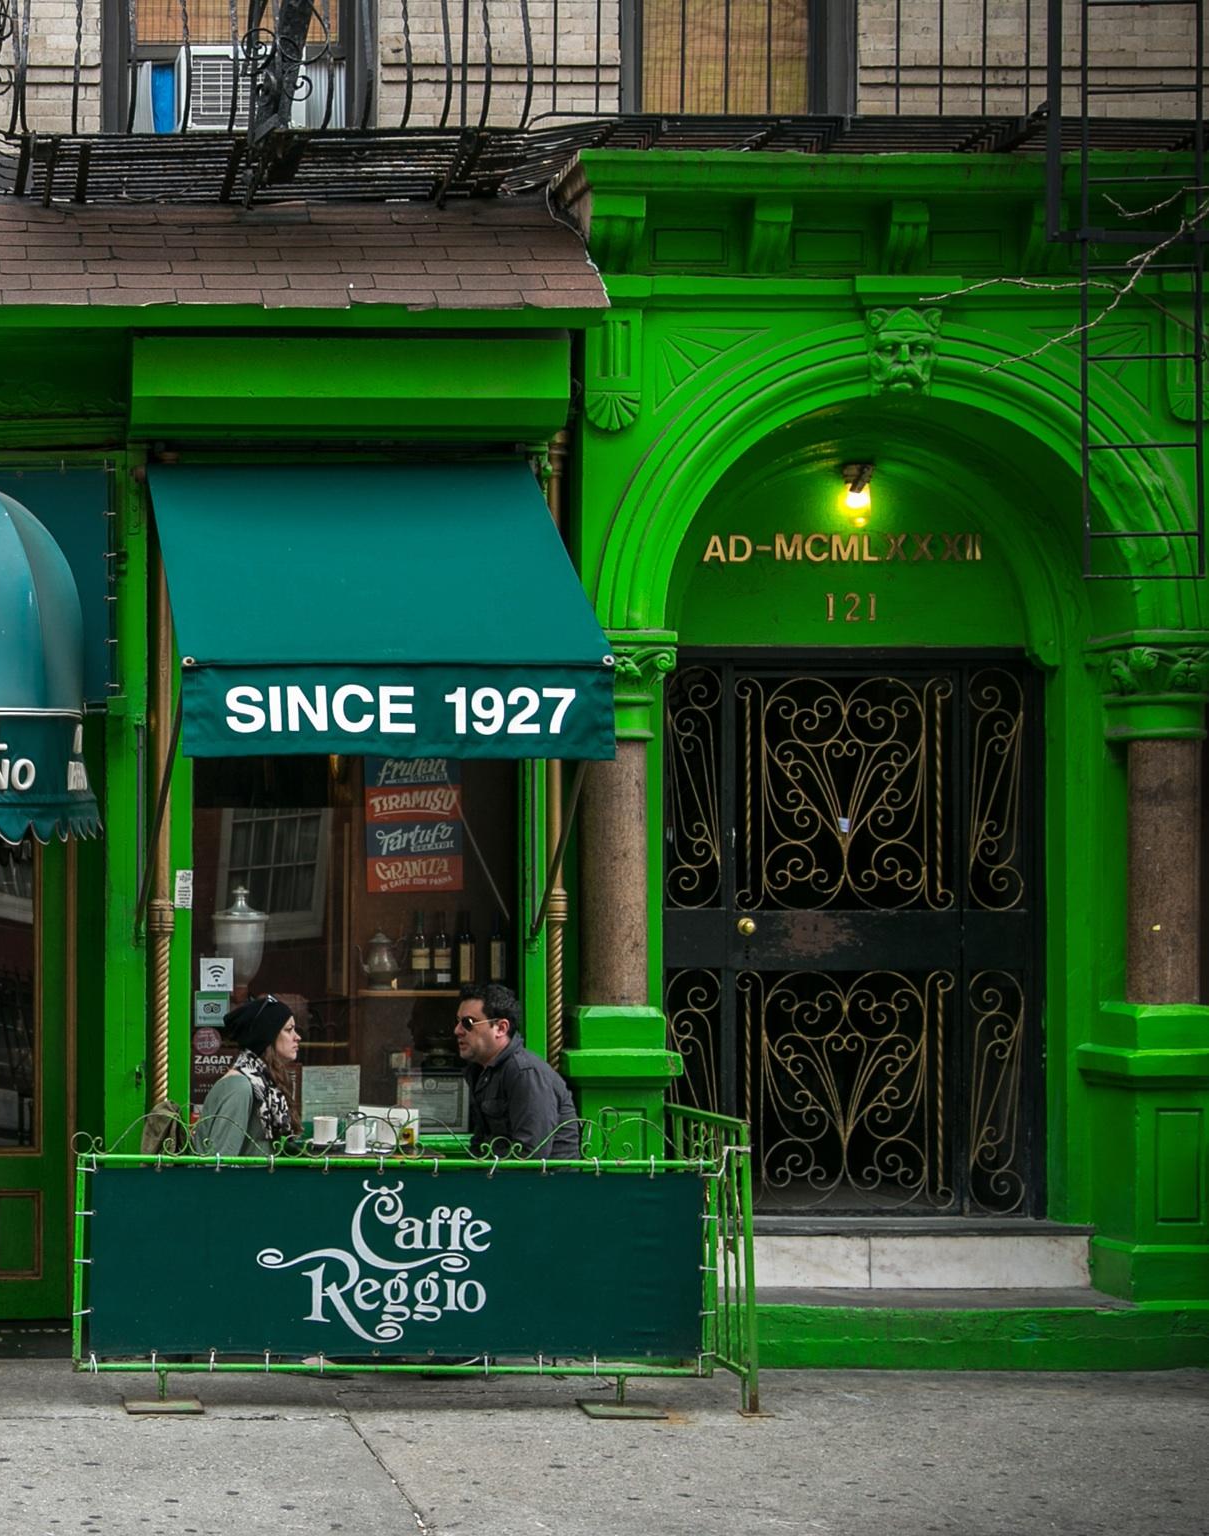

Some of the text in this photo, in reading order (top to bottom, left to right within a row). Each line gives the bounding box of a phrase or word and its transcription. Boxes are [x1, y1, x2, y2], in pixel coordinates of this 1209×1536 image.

[825, 592, 877, 622] 121
[225, 685, 577, 736] SINCE 1927
[375, 822, 454, 856] Tartufo
[375, 858, 450, 881] GRANITA
[194, 1055, 233, 1065] ZAGAT
[351, 1179, 492, 1273] Caffe
[256, 1247, 488, 1344] Reggio
